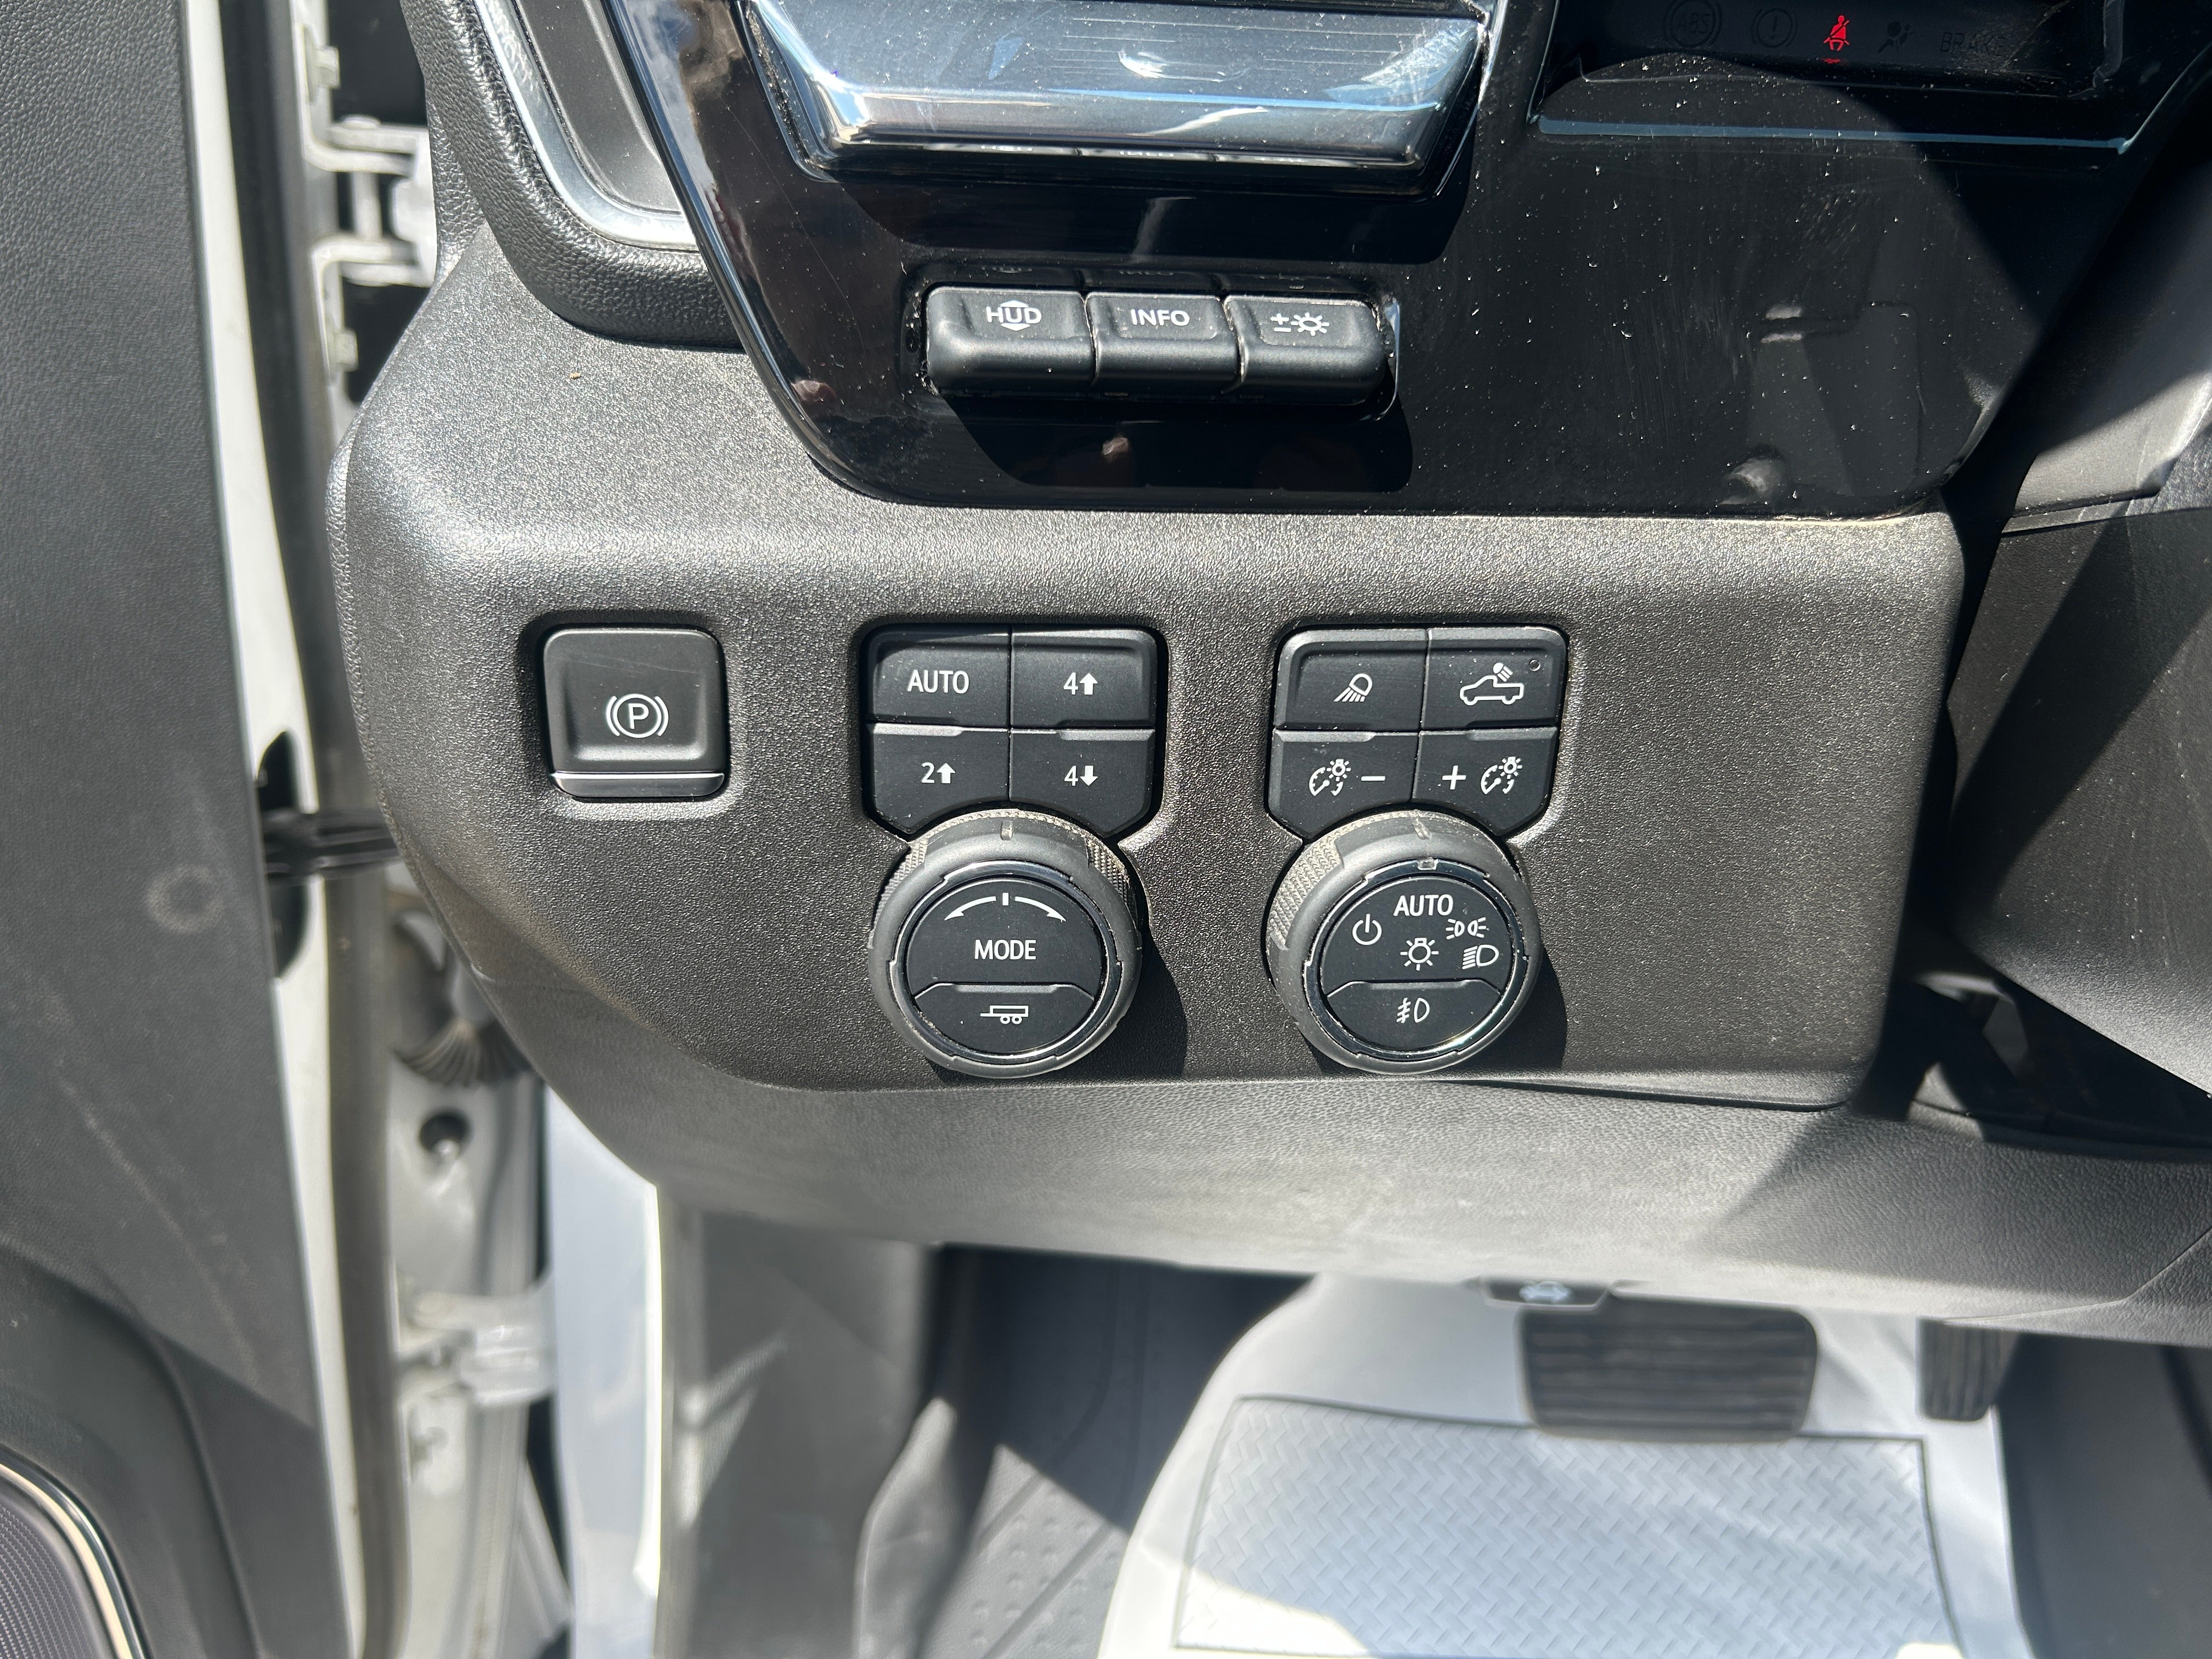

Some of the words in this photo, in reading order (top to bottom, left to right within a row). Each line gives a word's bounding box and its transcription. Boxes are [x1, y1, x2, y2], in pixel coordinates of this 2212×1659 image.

[1677, 13, 1711, 34] ABS
[1940, 31, 2004, 57] BRAKE
[986, 306, 1042, 325] HUD
[1130, 308, 1190, 328] INFO
[906, 668, 970, 694] AUTO
[628, 704, 647, 729] P
[1393, 894, 1454, 917] AUTO
[974, 939, 1036, 960] MODE
